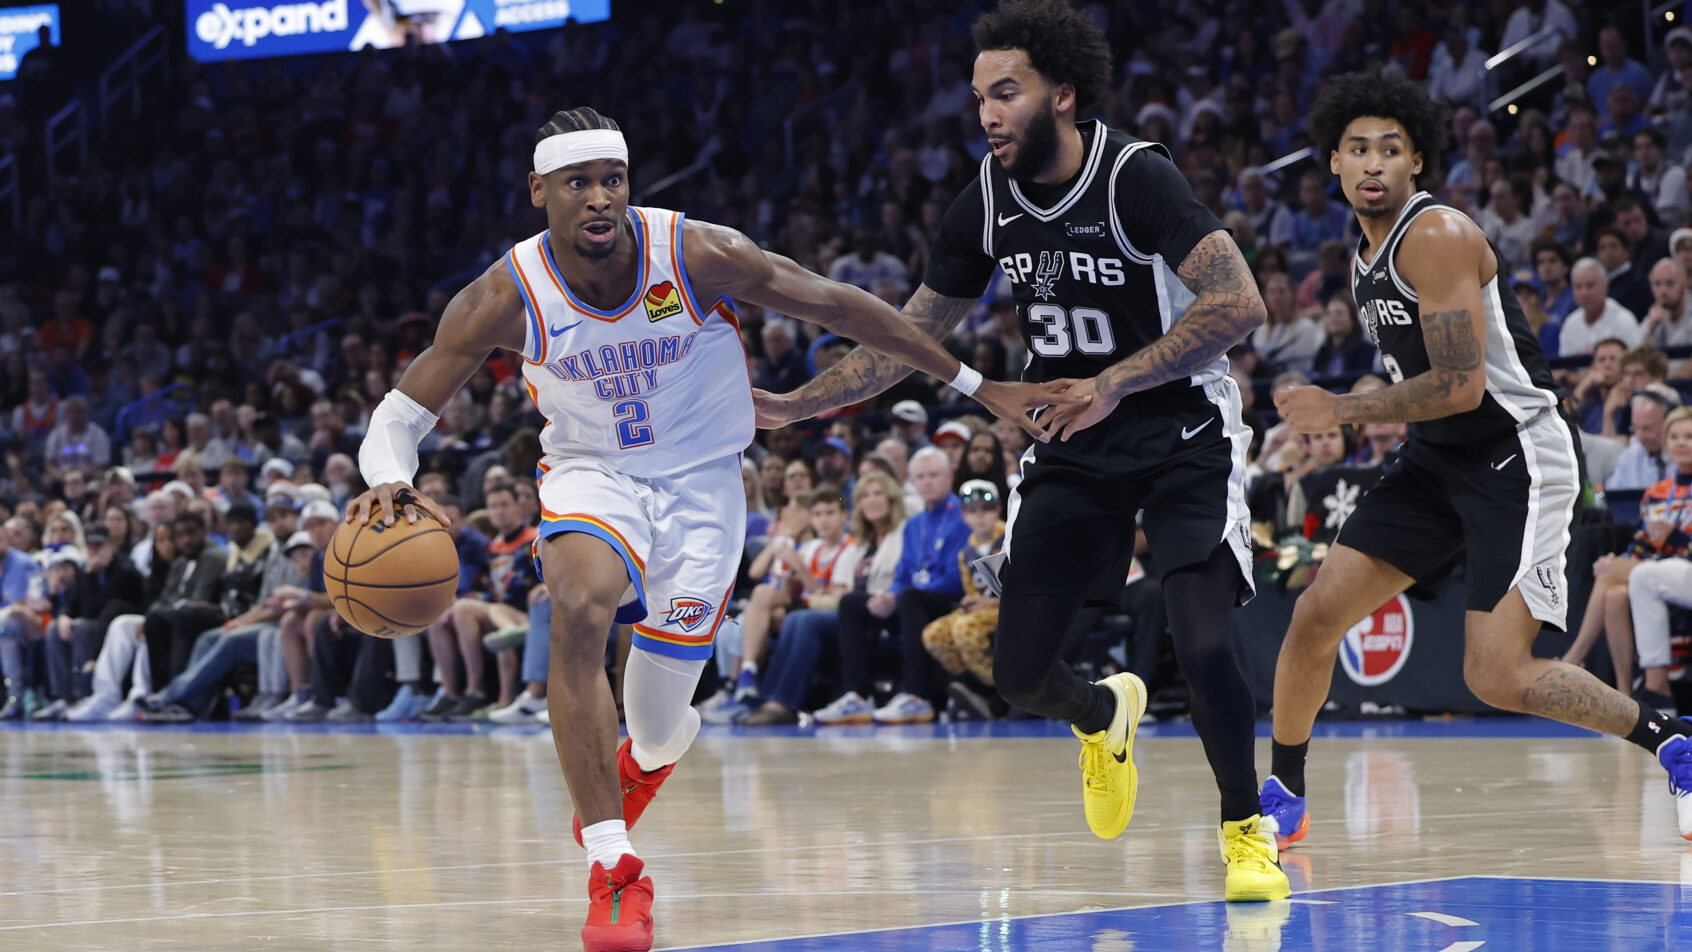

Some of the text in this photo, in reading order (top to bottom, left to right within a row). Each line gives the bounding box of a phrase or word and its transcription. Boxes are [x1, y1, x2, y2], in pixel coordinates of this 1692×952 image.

[195, 0, 349, 49] expand
[1069, 226, 1100, 234] LEDGER
[999, 251, 1126, 300] SPURS
[1027, 303, 1117, 357] 30
[543, 332, 697, 381] OKLAHOMA
[595, 369, 657, 400] CITY
[612, 399, 655, 450] 2
[667, 605, 704, 622] OKC
[1362, 634, 1403, 651] ESPN
